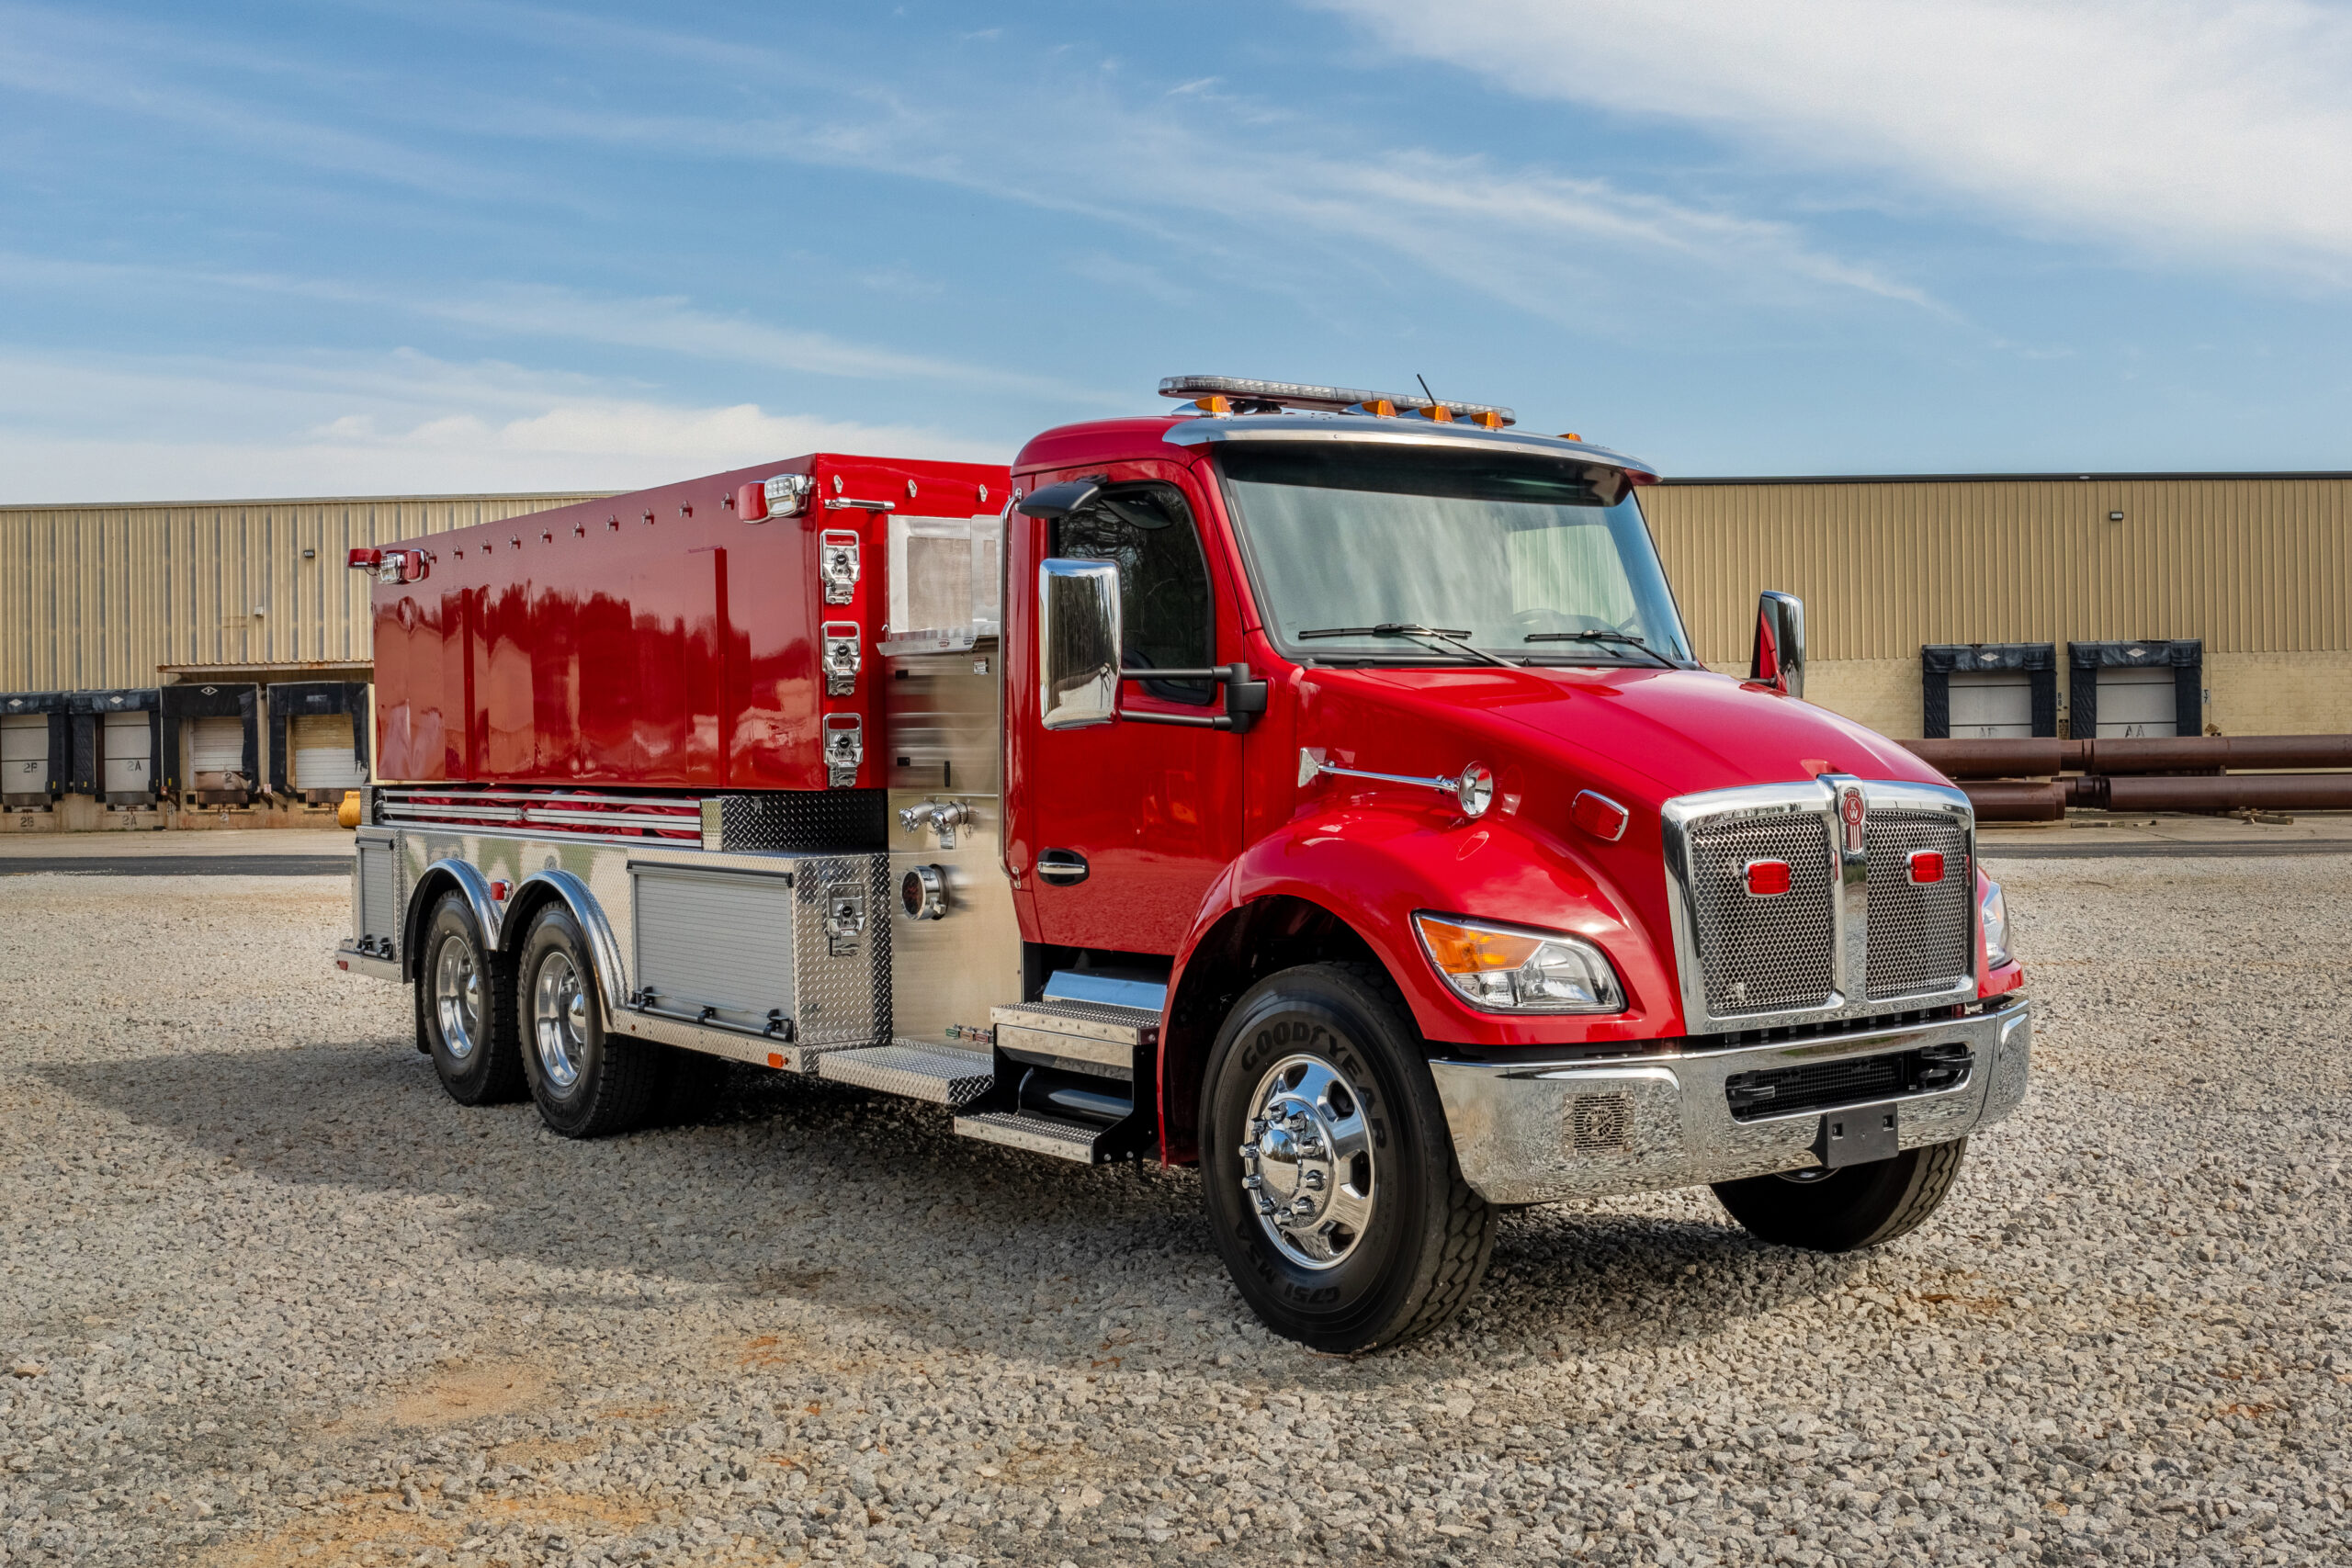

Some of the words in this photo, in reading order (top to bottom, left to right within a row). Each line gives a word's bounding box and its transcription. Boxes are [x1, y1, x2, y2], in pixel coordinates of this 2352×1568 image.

[127, 761, 141, 772] 2A
[224, 773, 232, 784] 2
[122, 815, 137, 826] 2A
[1241, 1021, 1387, 1148] GOODYEAR
[1283, 1282, 1341, 1303] G751
